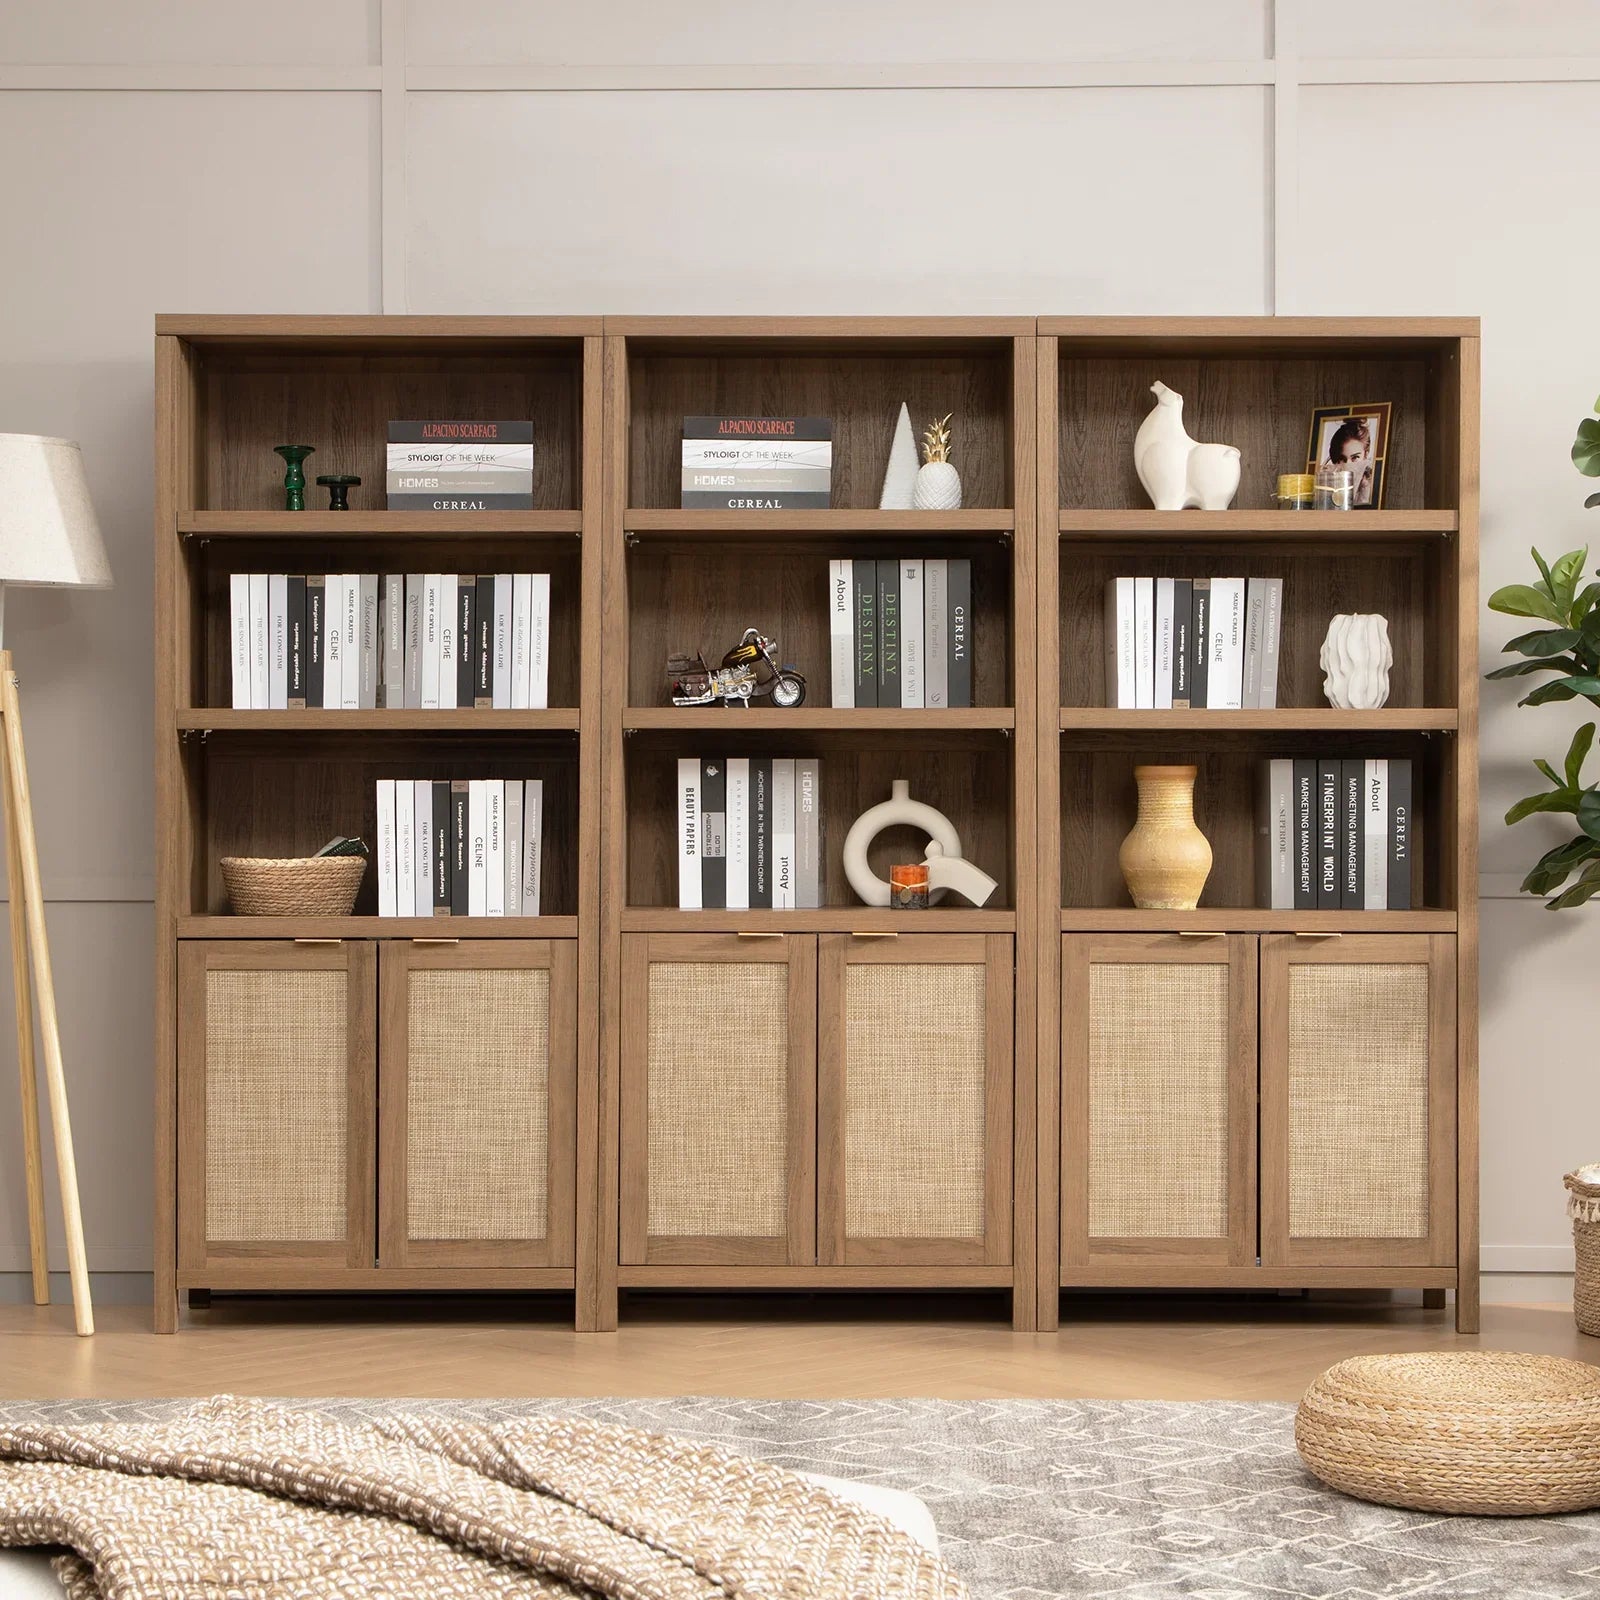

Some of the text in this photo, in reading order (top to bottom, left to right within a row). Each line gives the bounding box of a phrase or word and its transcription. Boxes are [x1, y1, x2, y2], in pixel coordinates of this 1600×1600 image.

[422, 424, 497, 438] ALPACINO SCARFACE
[718, 420, 796, 434] ALPACINO SCARFACE
[772, 451, 794, 459] WEEK
[398, 478, 439, 488] HOMES
[694, 476, 736, 486] HOMES
[433, 501, 486, 510] CEREAL
[728, 499, 782, 509] CEREAL
[836, 578, 846, 612] About
[364, 595, 374, 650] Discontent
[862, 594, 872, 675] DESTINY
[886, 593, 896, 674] DESTINY
[954, 606, 964, 661] CEREAL
[330, 630, 338, 661] CELINE
[1214, 632, 1223, 662] CELINE
[802, 772, 812, 812] HOMES
[1372, 778, 1380, 812] About
[686, 788, 695, 856] BEAUTY PAPERS
[1324, 774, 1334, 892] FINGERPRINT WORLD
[1396, 806, 1406, 861] CEREAL
[474, 836, 482, 868] CELINE
[526, 841, 538, 896] Discontent
[780, 856, 788, 890] About
